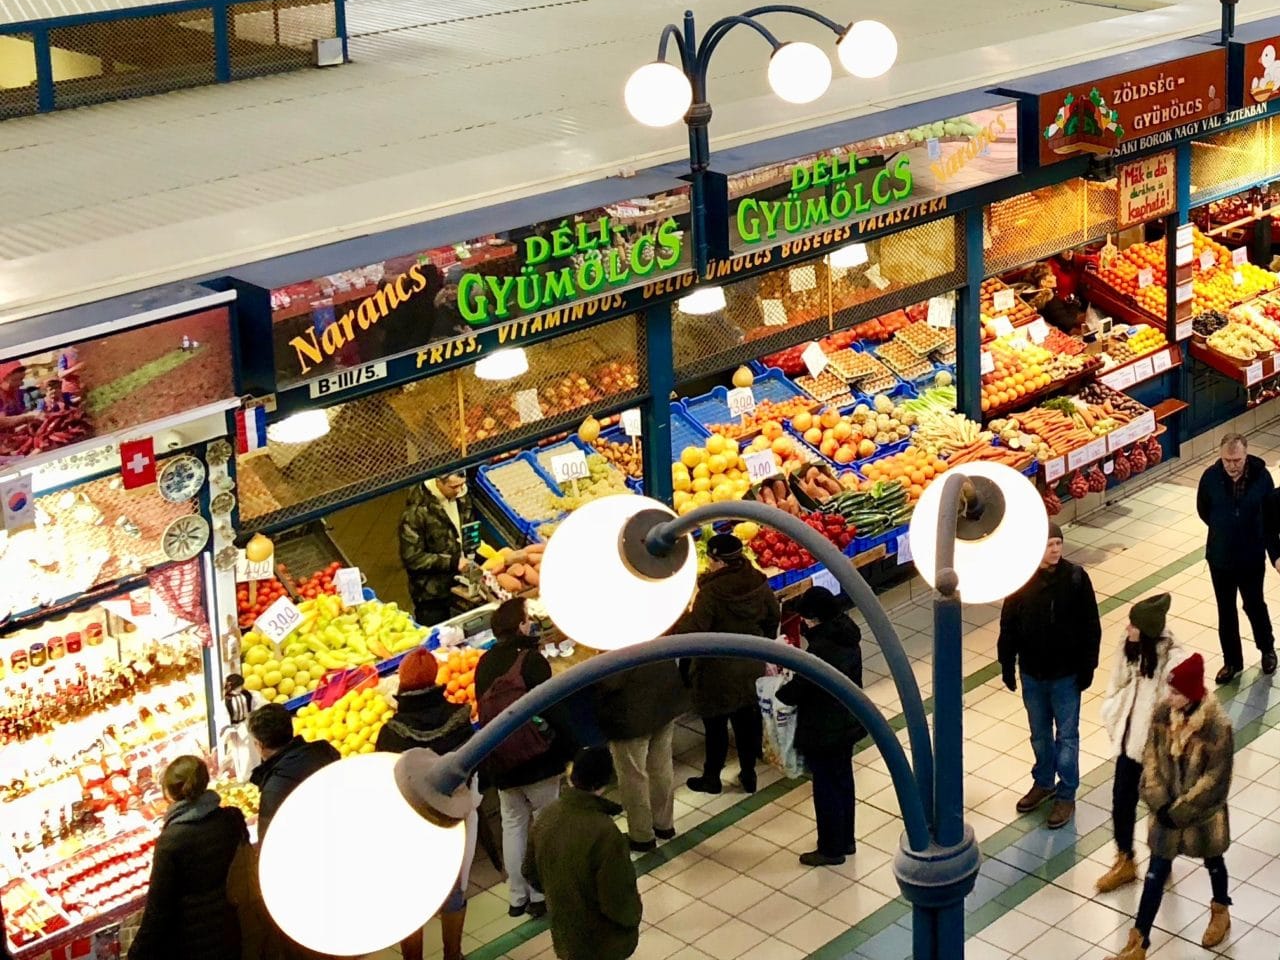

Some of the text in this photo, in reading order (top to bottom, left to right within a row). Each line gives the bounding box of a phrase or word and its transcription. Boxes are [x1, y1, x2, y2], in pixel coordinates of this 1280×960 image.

[1140, 130, 1173, 150] BOROK
[1174, 120, 1200, 140] NAGY
[737, 155, 914, 243] GYÜMÖLCS
[457, 217, 684, 325] GYÜMÖLCS
[289, 262, 428, 375] Narancs
[318, 365, 380, 395] B-III/5.
[416, 336, 483, 368] FRISS,
